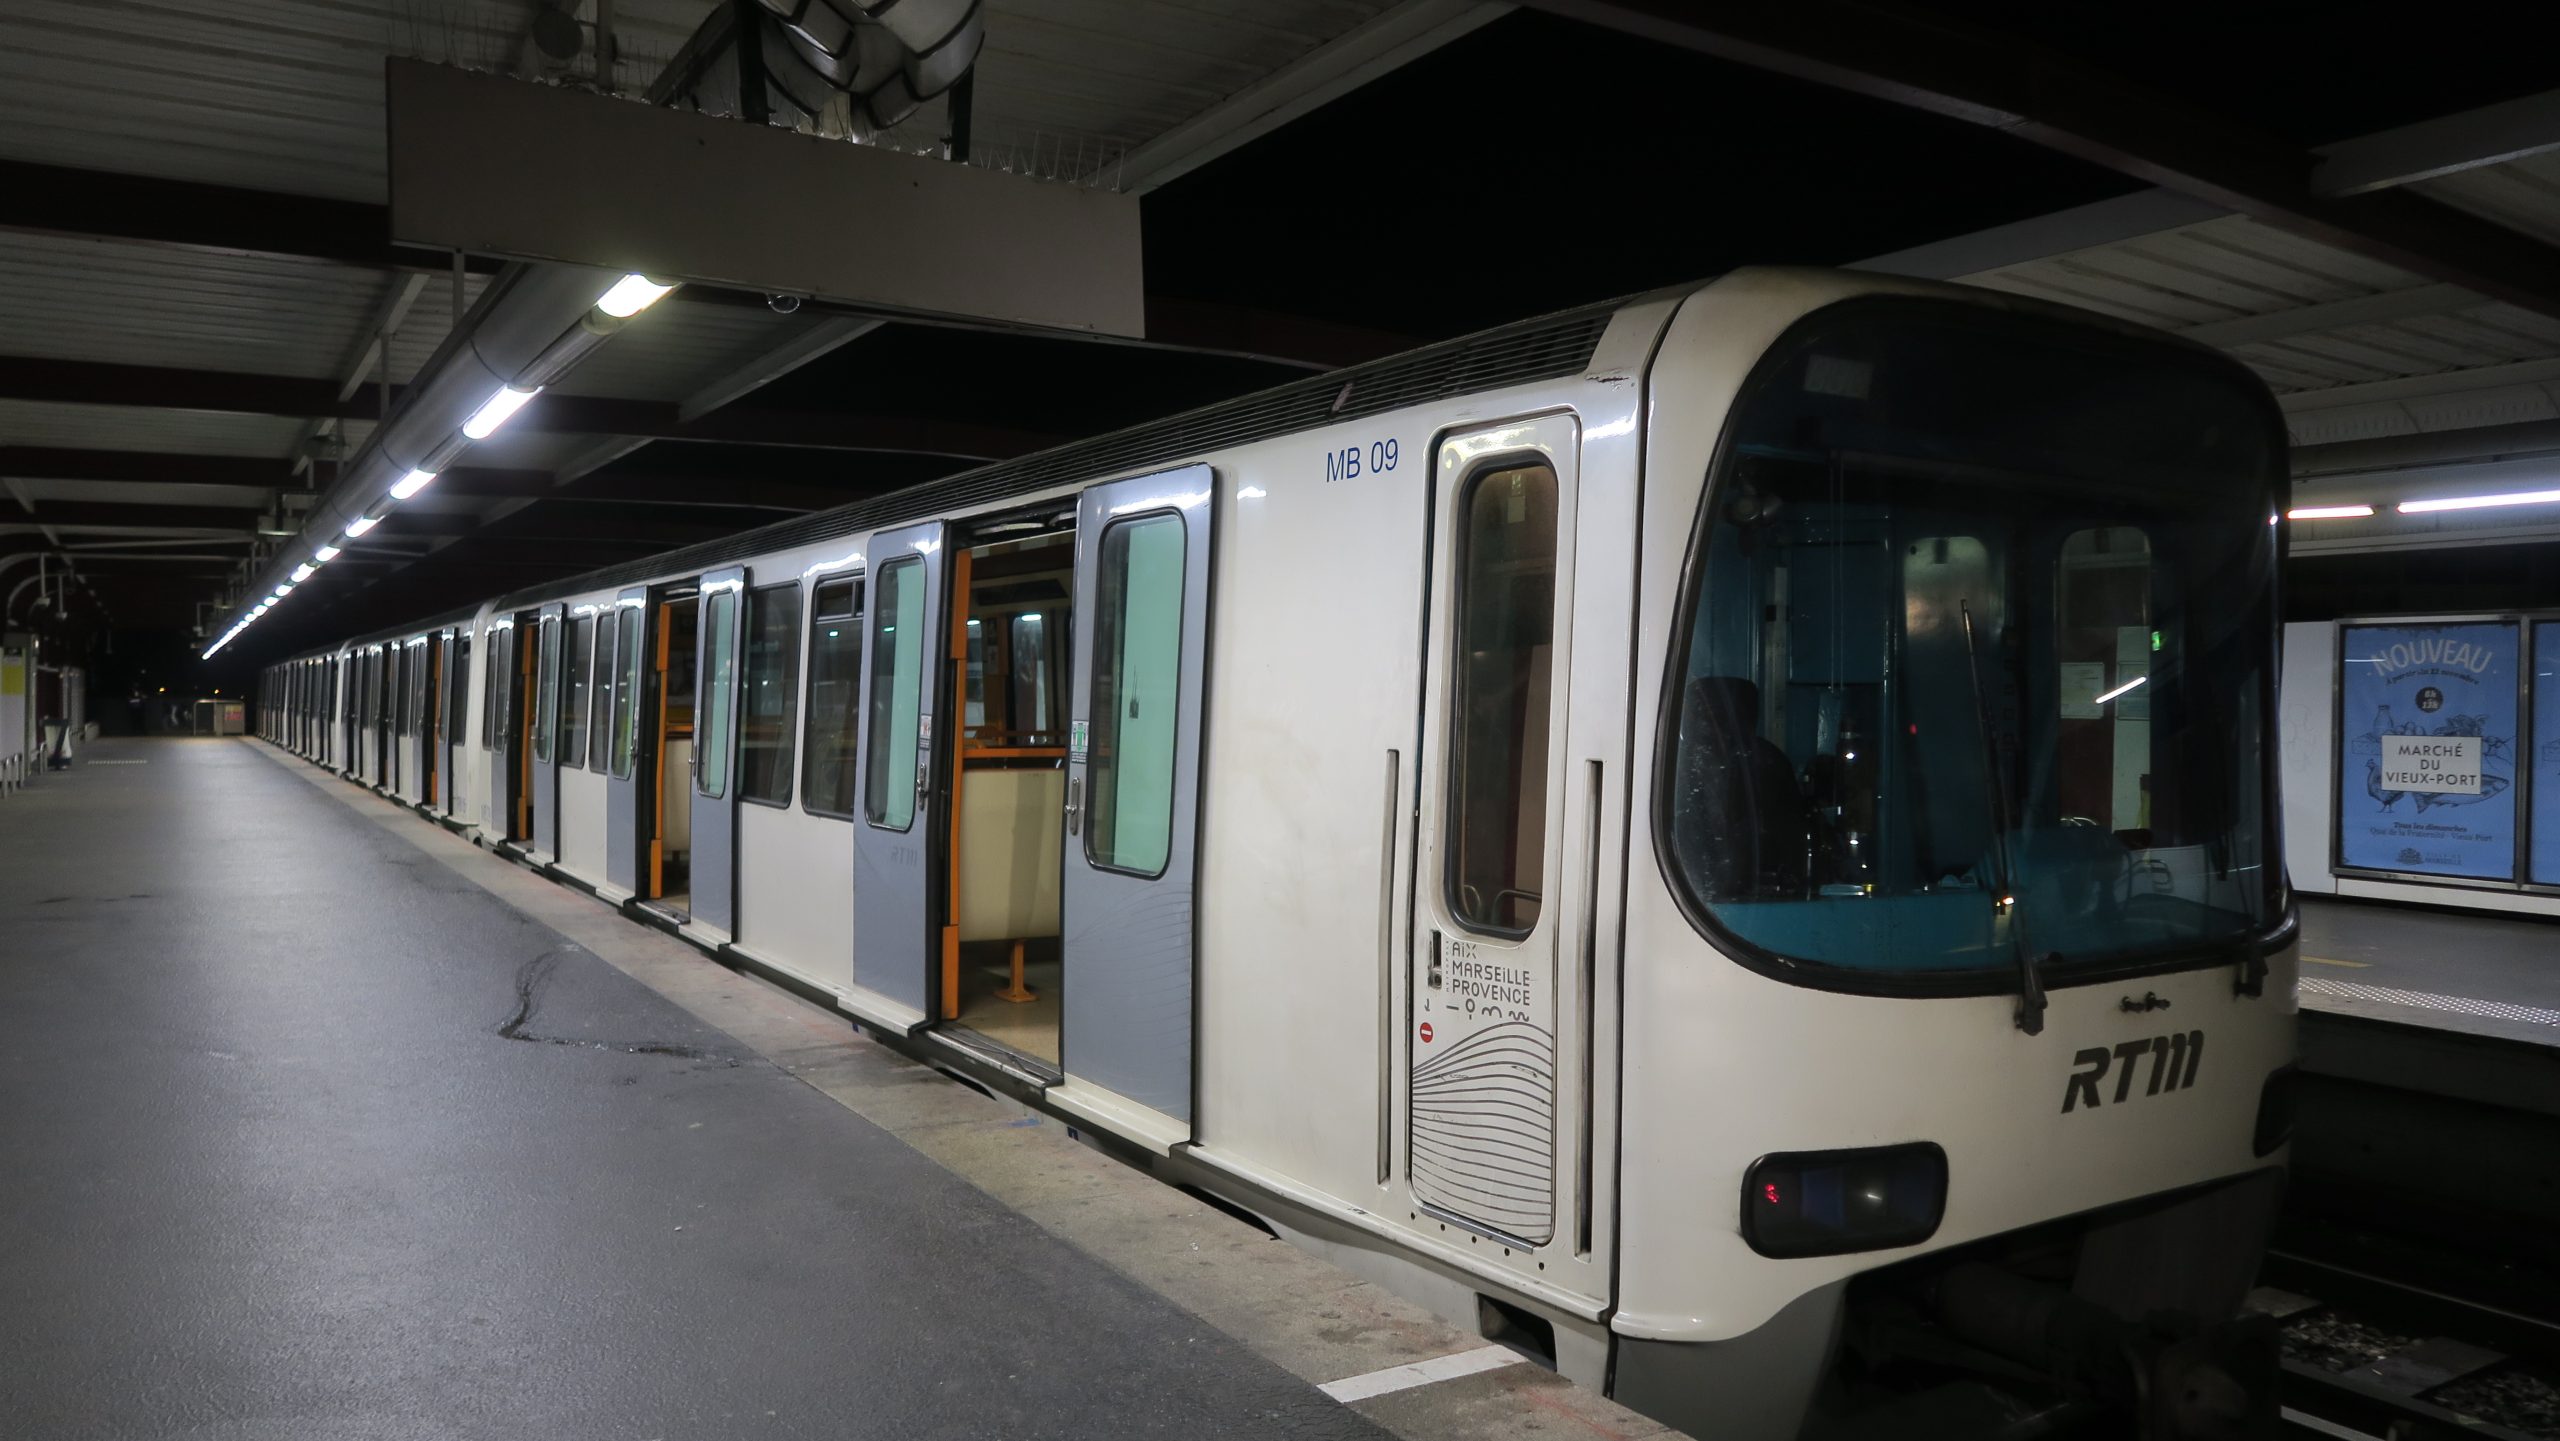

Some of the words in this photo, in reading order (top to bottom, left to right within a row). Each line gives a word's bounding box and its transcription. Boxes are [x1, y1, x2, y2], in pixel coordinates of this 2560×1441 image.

[1326, 446, 1361, 483] MB
[1370, 438, 1399, 474] 09
[2370, 638, 2493, 676] NOUVEAU
[2399, 743, 2463, 757] MARCHÉ
[2386, 772, 2477, 786] VIEUX-PORT
[2420, 759, 2440, 771] DU
[1452, 978, 1530, 1006] PROVENCE
[2060, 1029, 2204, 1114] RTM
